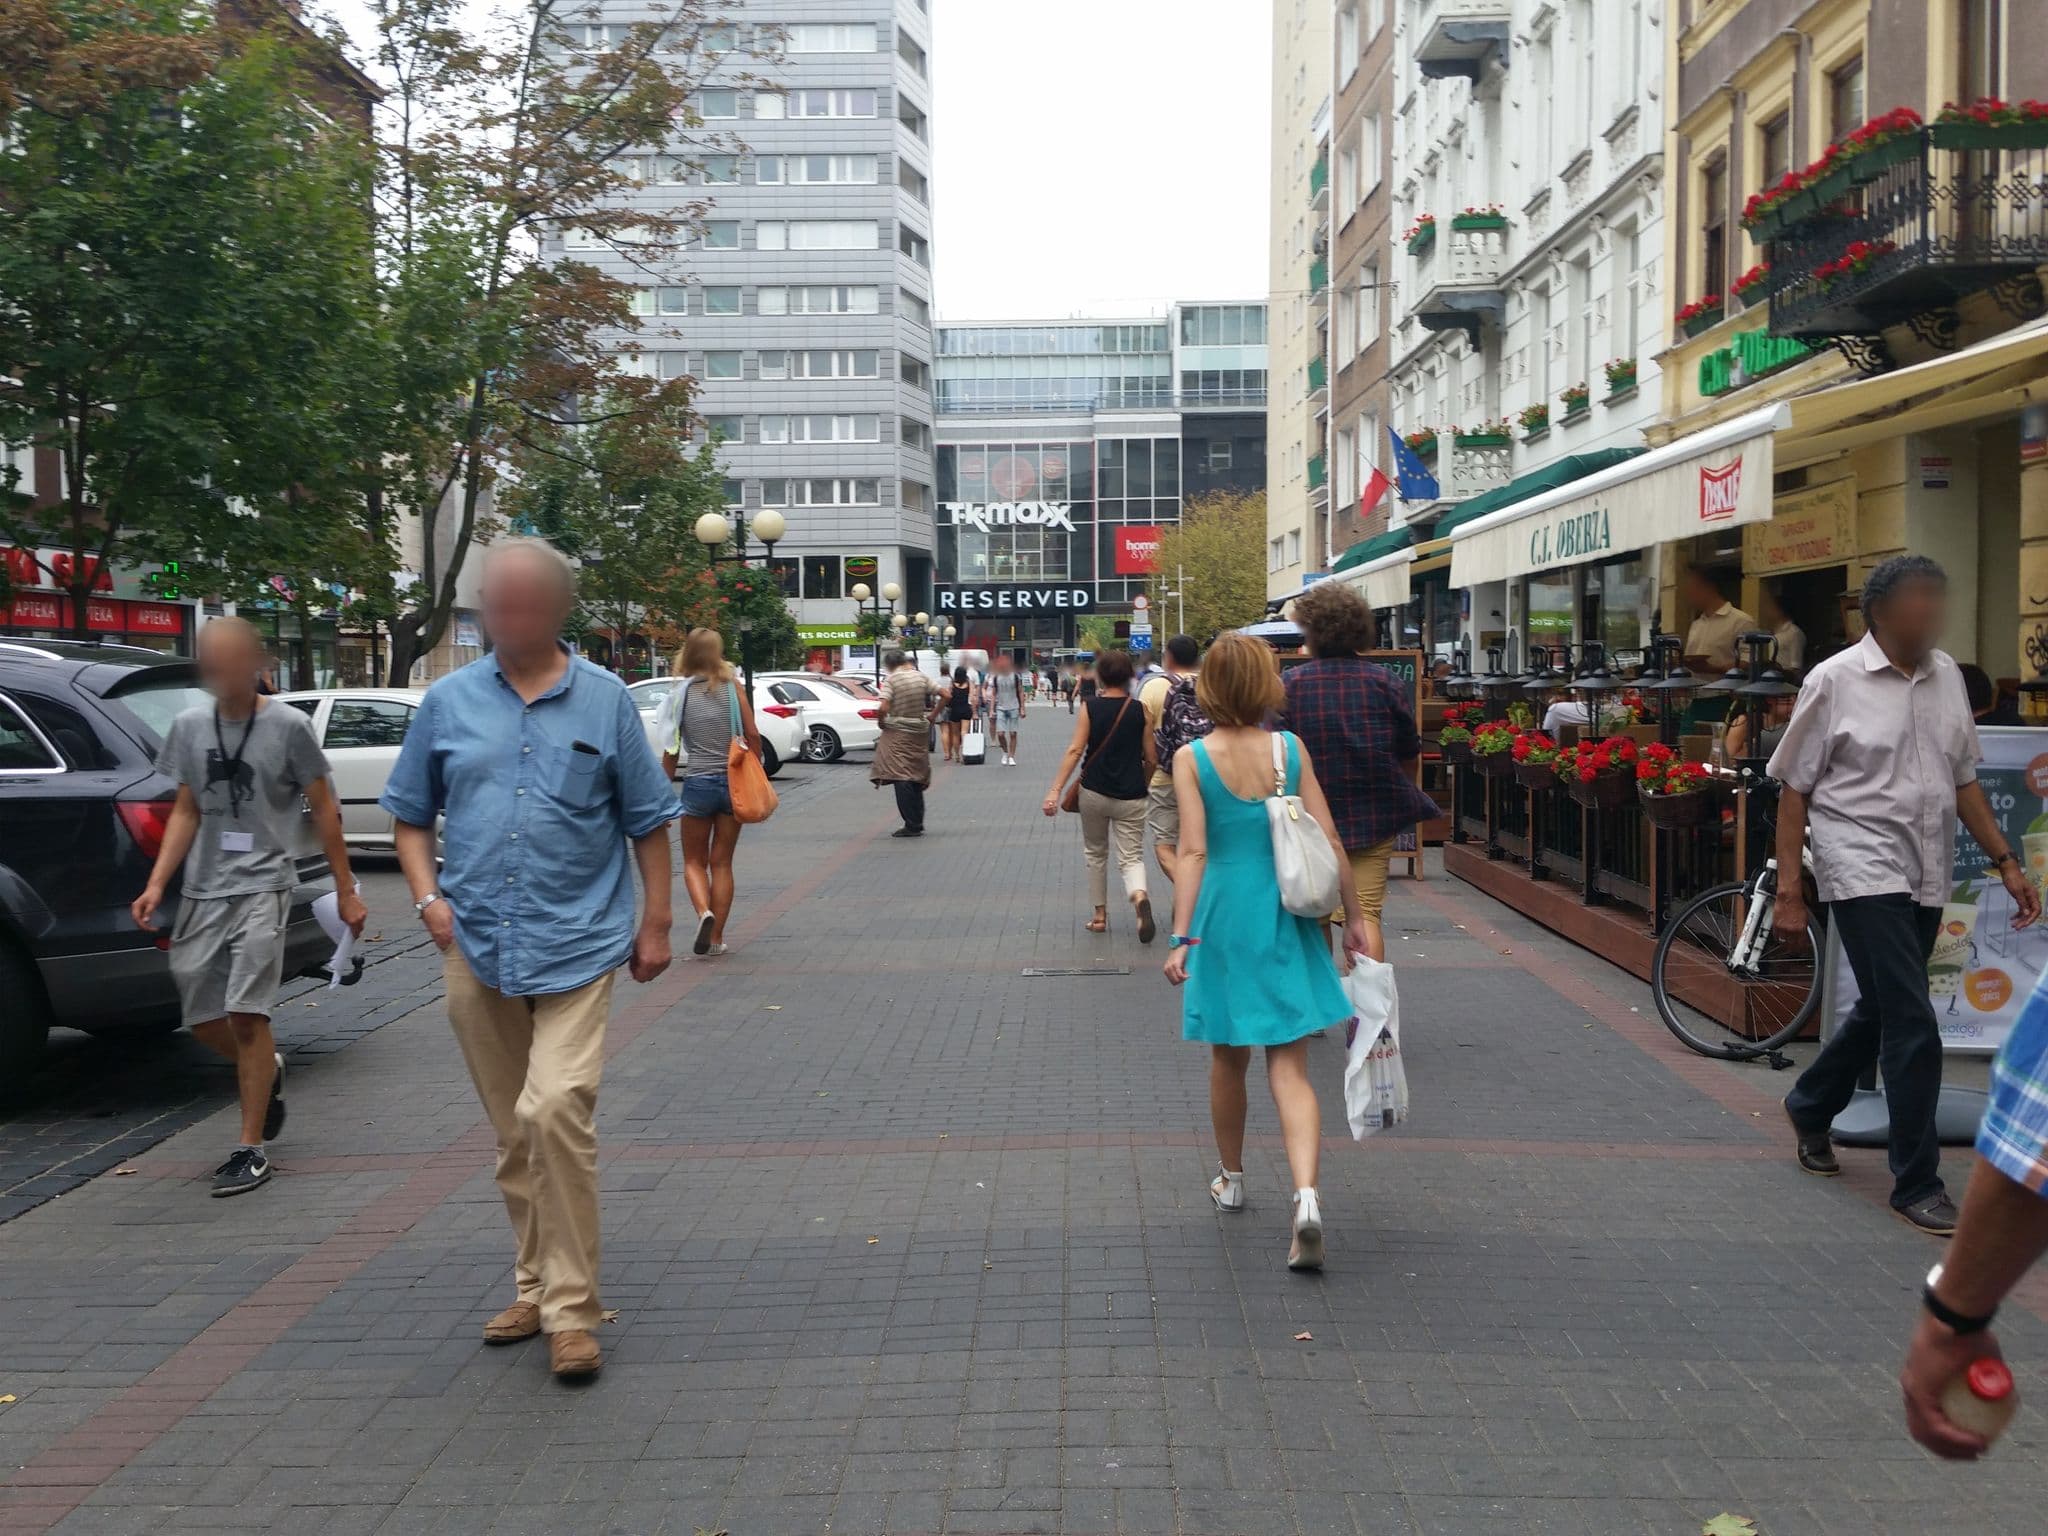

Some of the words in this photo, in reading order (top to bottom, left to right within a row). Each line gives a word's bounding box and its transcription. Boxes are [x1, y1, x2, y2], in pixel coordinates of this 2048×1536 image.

[1125, 539, 1160, 550] home
[940, 590, 1089, 609] RESERVED
[15, 600, 56, 618] APTEKA
[138, 609, 172, 626] APTEKA
